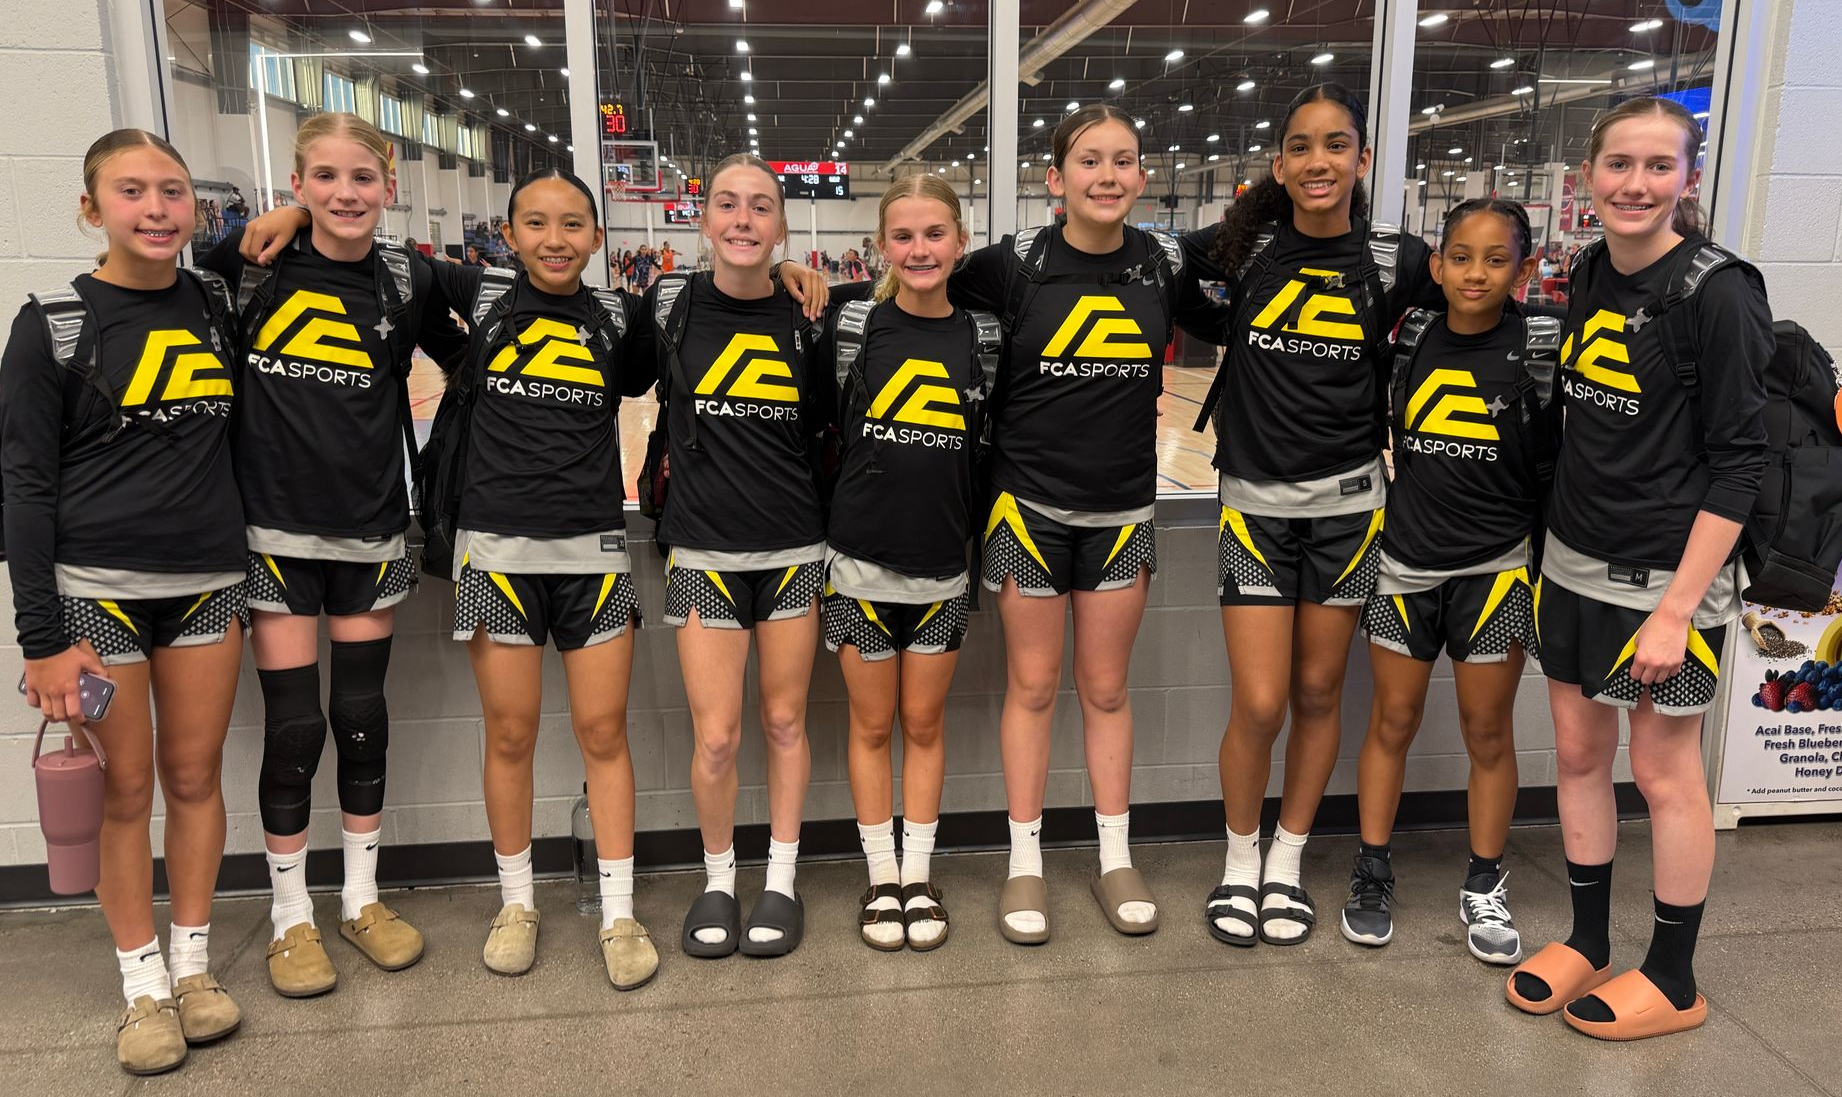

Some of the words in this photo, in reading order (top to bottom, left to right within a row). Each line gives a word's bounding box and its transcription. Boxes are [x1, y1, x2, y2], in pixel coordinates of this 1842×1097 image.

[606, 114, 626, 133] 30
[800, 174, 820, 185] 4:28
[1561, 375, 1640, 415] ASPORTS
[1635, 572, 1643, 581] M
[1755, 725, 1781, 736] Acai
[1784, 725, 1815, 736] Base,
[1818, 724, 1842, 735] Fres
[1764, 739, 1795, 750] Fresh
[1780, 752, 1828, 764] Granola,
[1795, 767, 1833, 779] Honey
[1767, 787, 1791, 795] peanut
[1792, 786, 1813, 794] butter
